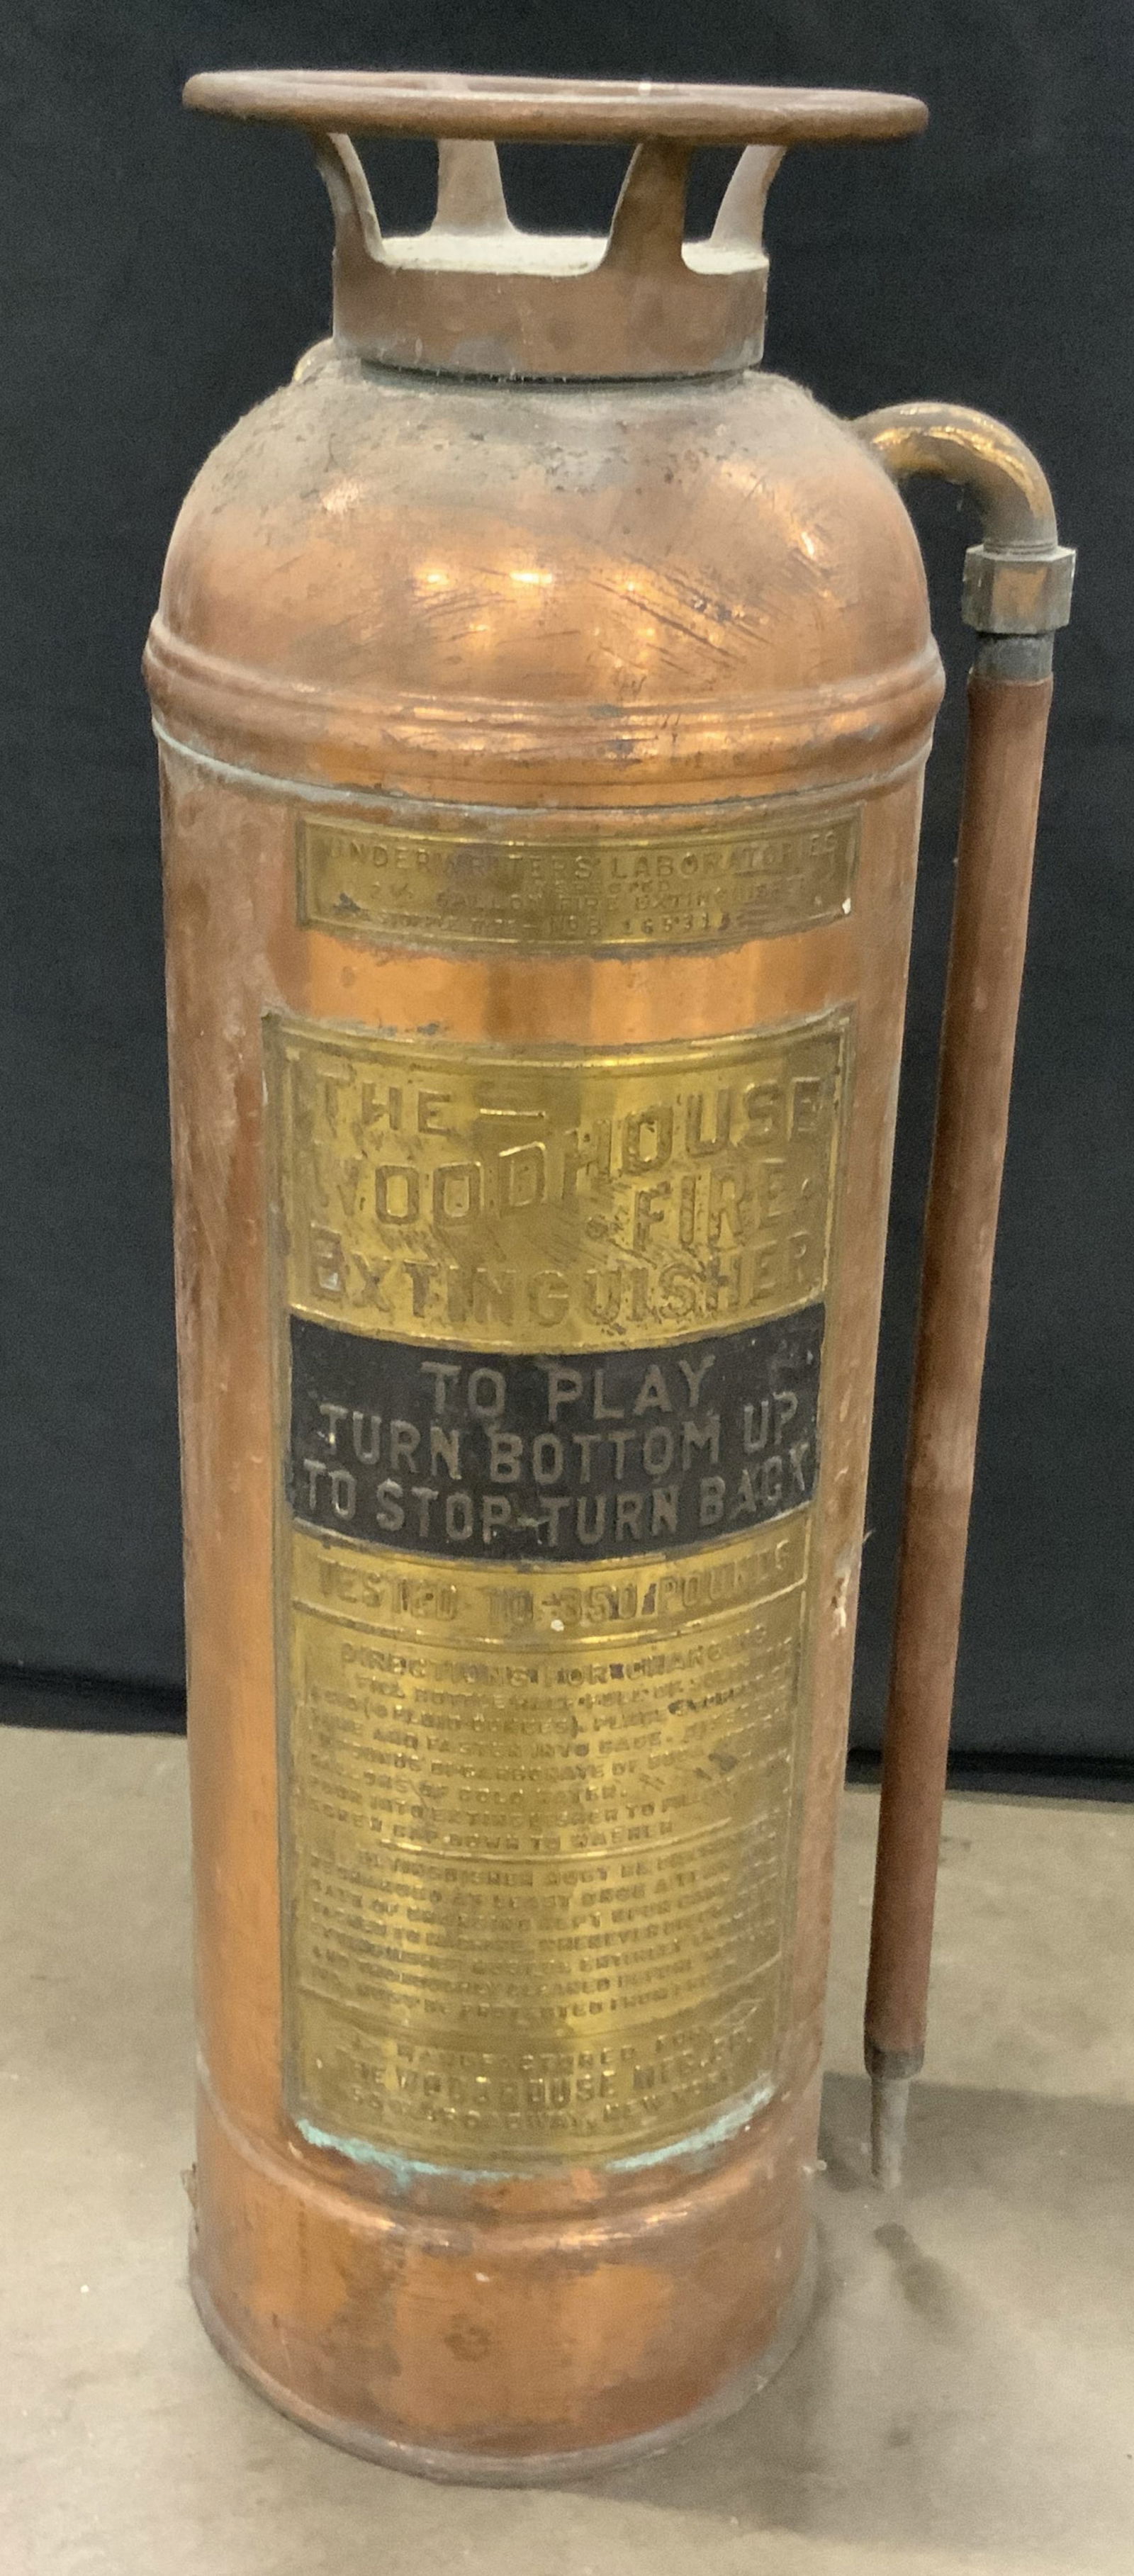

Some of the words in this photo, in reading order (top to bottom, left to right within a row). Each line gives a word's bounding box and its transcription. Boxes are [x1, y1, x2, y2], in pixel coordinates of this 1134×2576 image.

[558, 894, 619, 913] FIRE
[318, 1067, 452, 1134] THE
[309, 1076, 823, 1226] WOODHOUSE
[630, 1158, 787, 1253] FIRE
[309, 1222, 811, 1327] EXTINGUISHER
[421, 1360, 506, 1416] TO
[546, 1355, 717, 1422] PLAY
[319, 1402, 461, 1480] TURN
[489, 1419, 720, 1485] BOTTOM
[743, 1391, 799, 1455] UP
[303, 1458, 356, 1521] TO
[698, 1443, 809, 1525] BACK
[319, 1562, 457, 1621] TESTED
